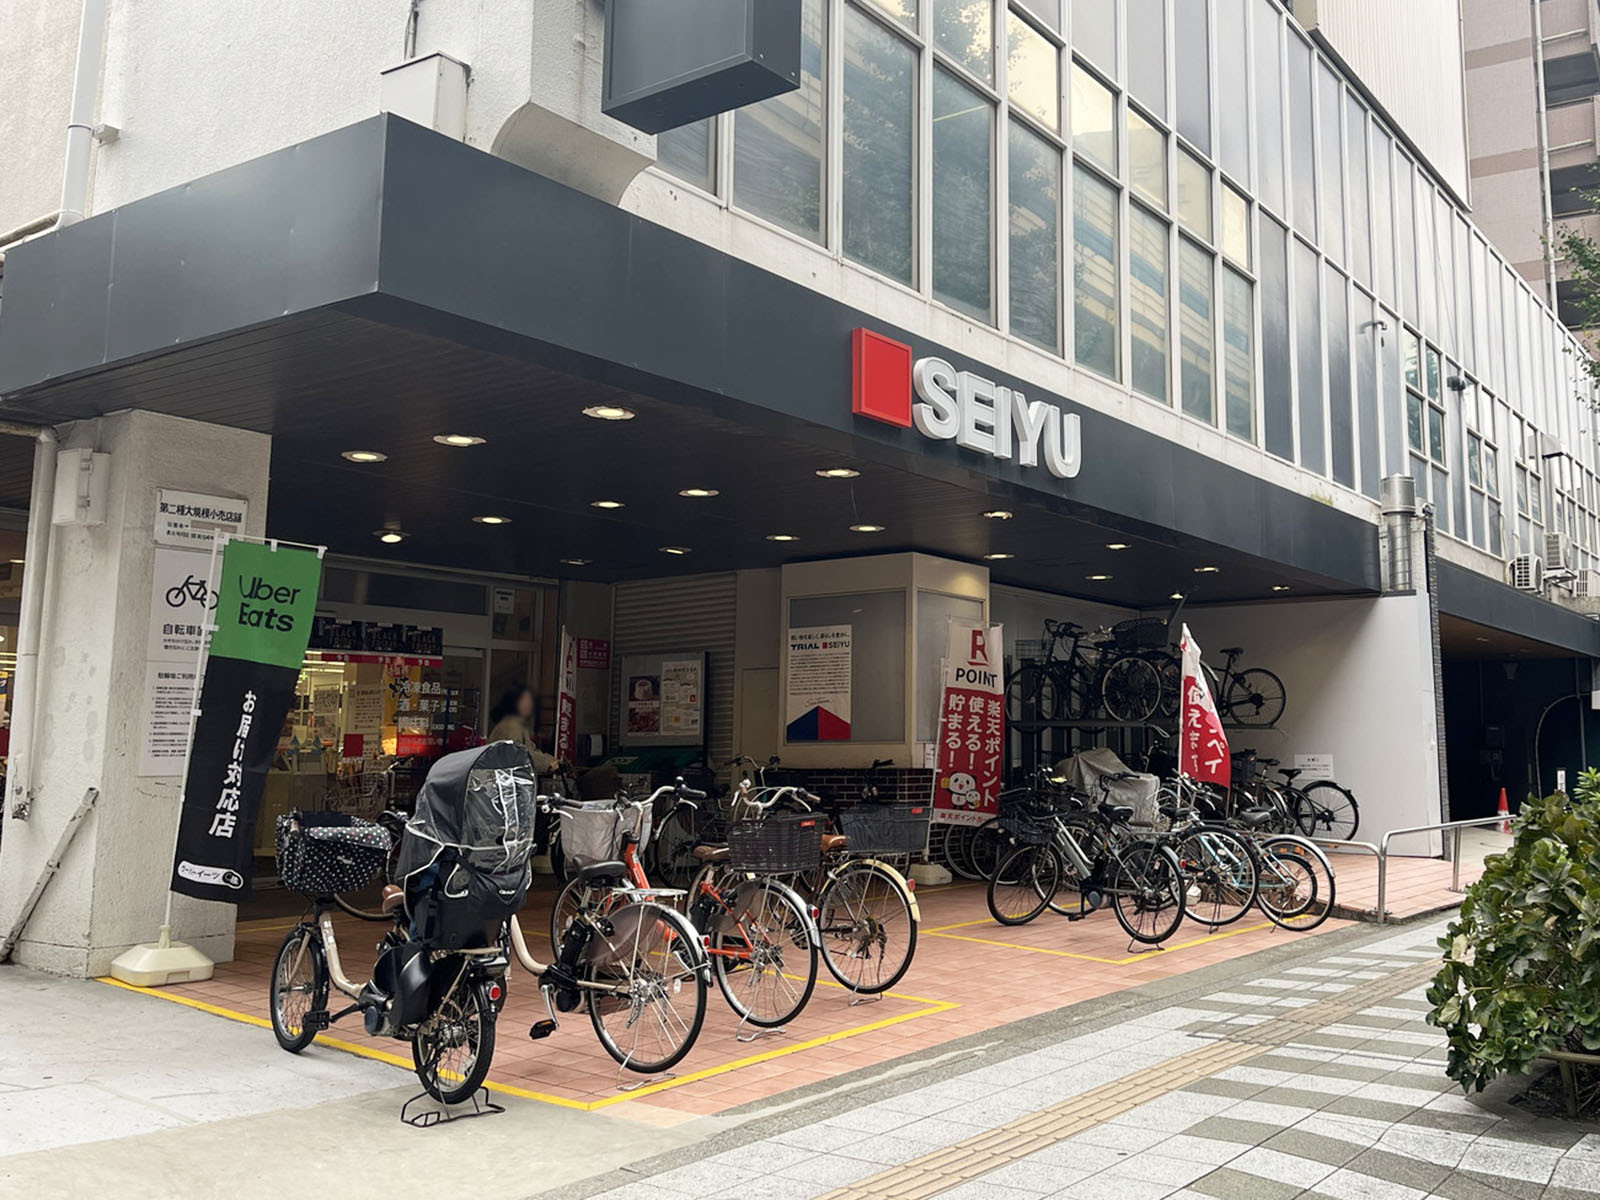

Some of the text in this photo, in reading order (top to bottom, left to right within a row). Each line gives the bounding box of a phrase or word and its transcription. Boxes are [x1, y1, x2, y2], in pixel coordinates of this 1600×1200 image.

[912, 356, 1082, 479] SEIYU
[238, 574, 301, 606] Uber
[238, 602, 296, 634] Eats
[791, 641, 850, 651] TRIAL SEIYU
[955, 667, 998, 689] POINT
[982, 699, 1001, 807] 楽天ポイント
